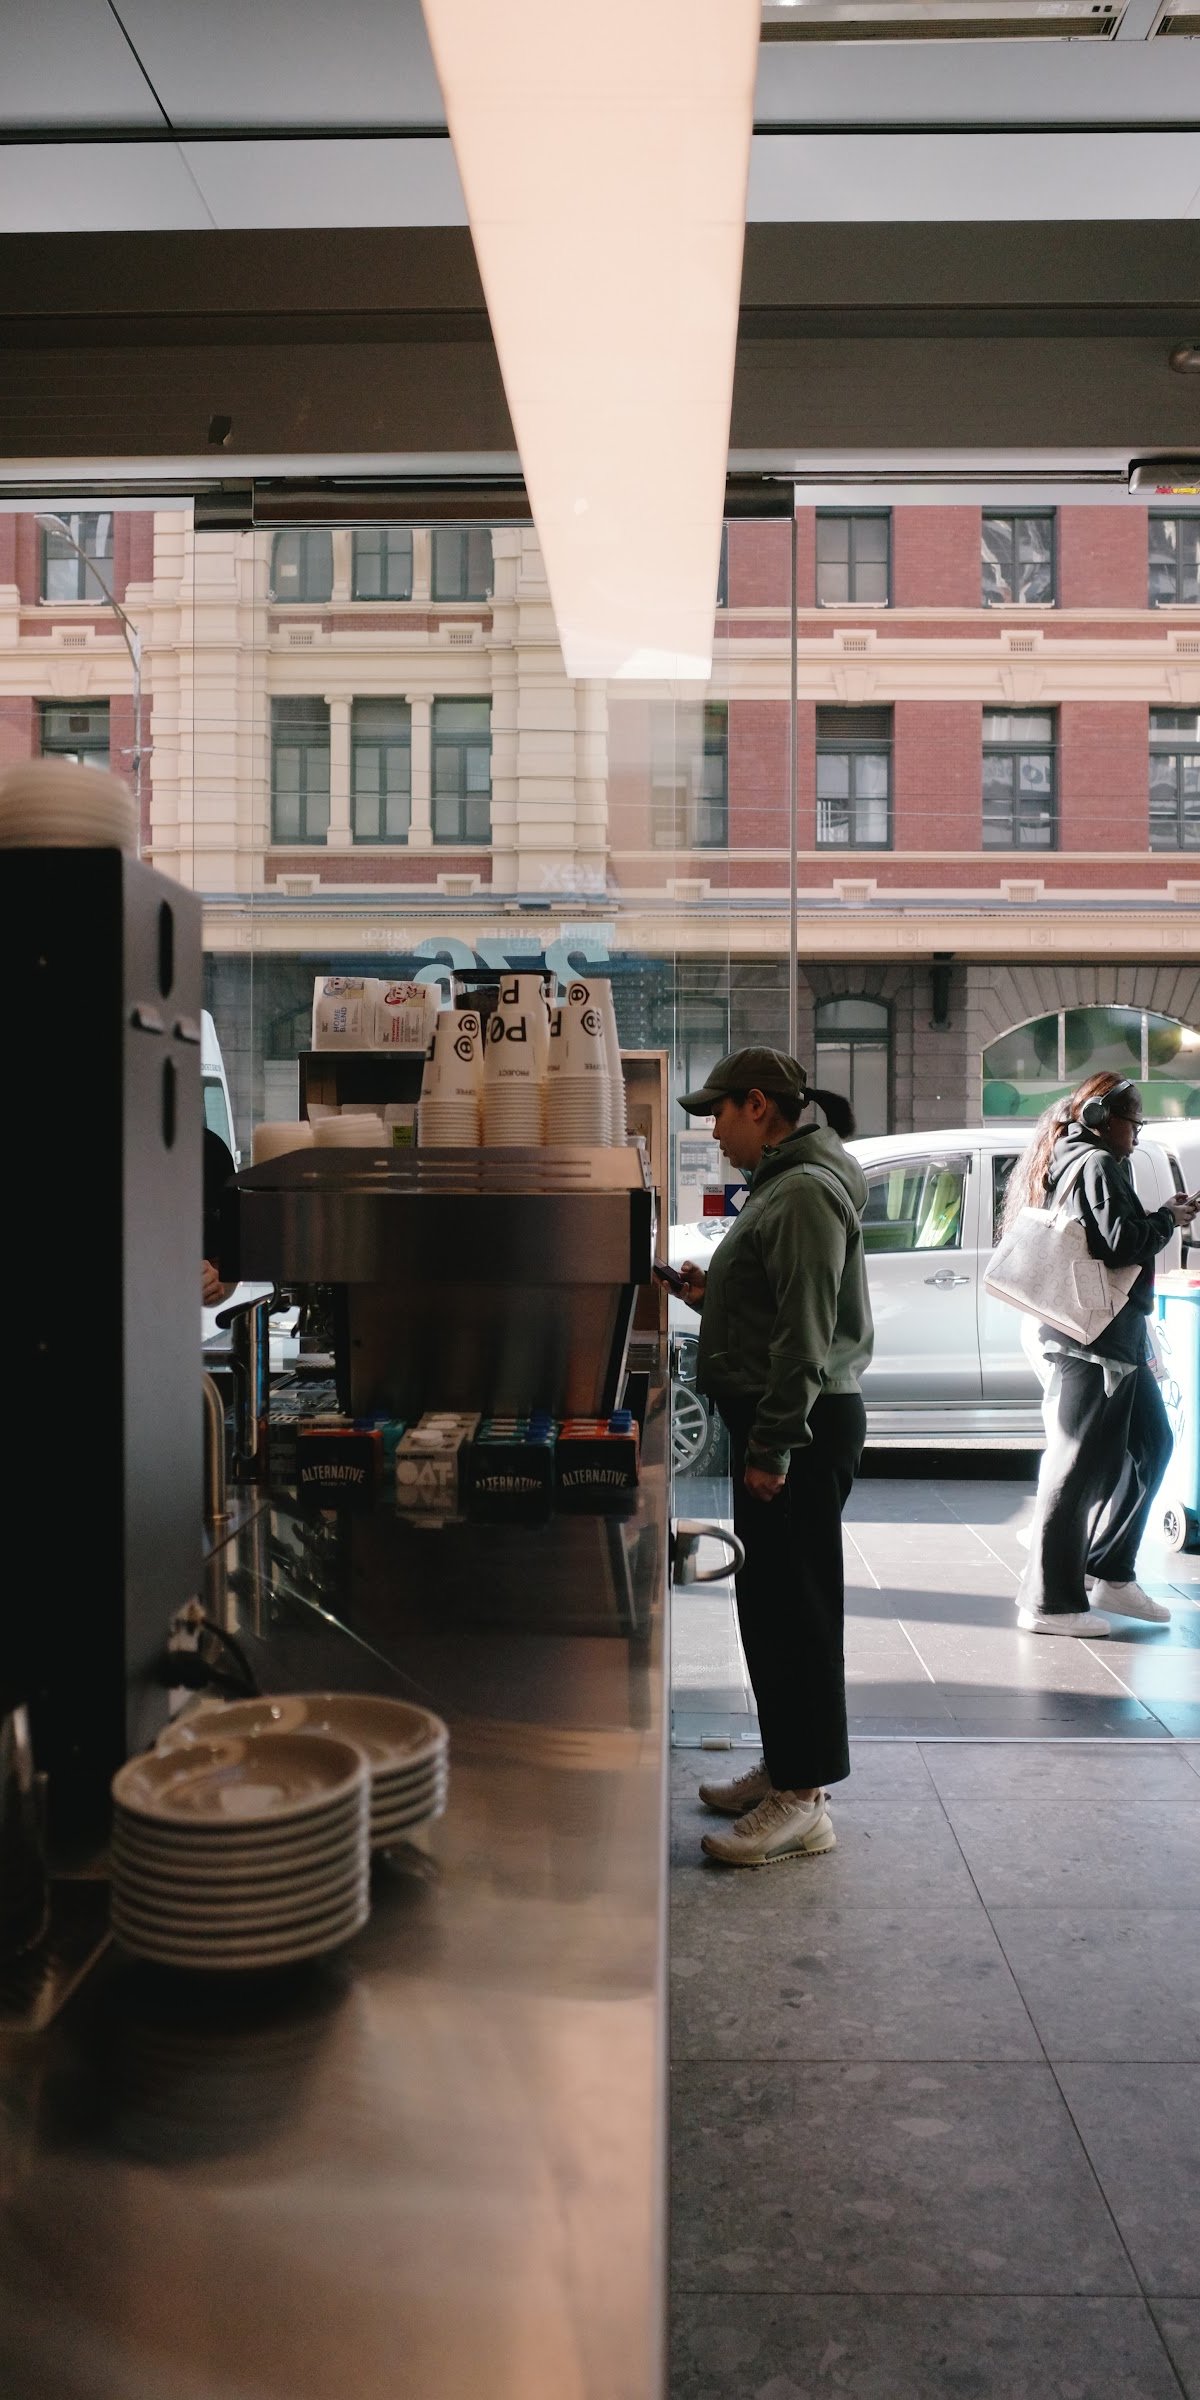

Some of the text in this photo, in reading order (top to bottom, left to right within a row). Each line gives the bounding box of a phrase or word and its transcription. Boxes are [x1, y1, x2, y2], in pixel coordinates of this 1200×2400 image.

[498, 1069, 530, 1077] PROJECT
[302, 1464, 365, 1484] ALTERNATIVE
[561, 1469, 628, 1488] ALTERNATIVE
